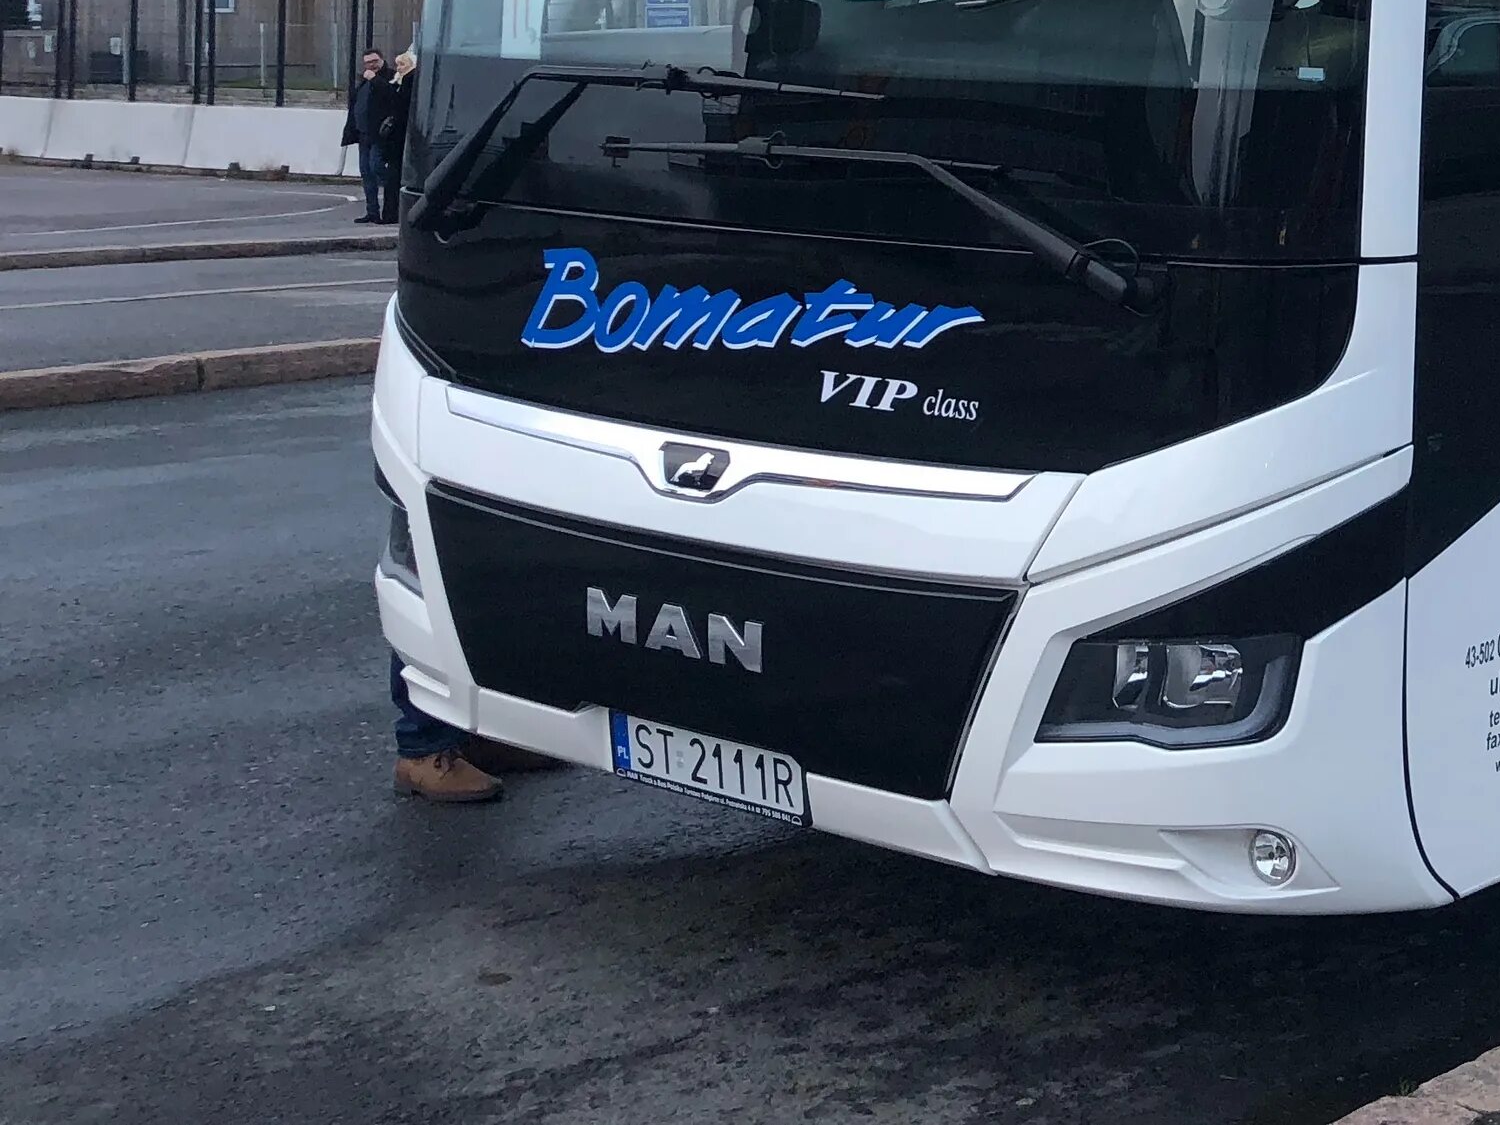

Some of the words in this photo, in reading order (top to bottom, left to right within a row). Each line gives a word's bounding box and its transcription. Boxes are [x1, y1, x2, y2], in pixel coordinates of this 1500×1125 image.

[520, 247, 985, 353] Bomatur
[818, 370, 918, 412] VIP
[923, 388, 980, 421] class
[586, 586, 765, 674] MAN
[1465, 639, 1495, 669] 43-502
[617, 745, 629, 760] PL
[635, 723, 674, 775] ST
[689, 737, 795, 809] 2111R
